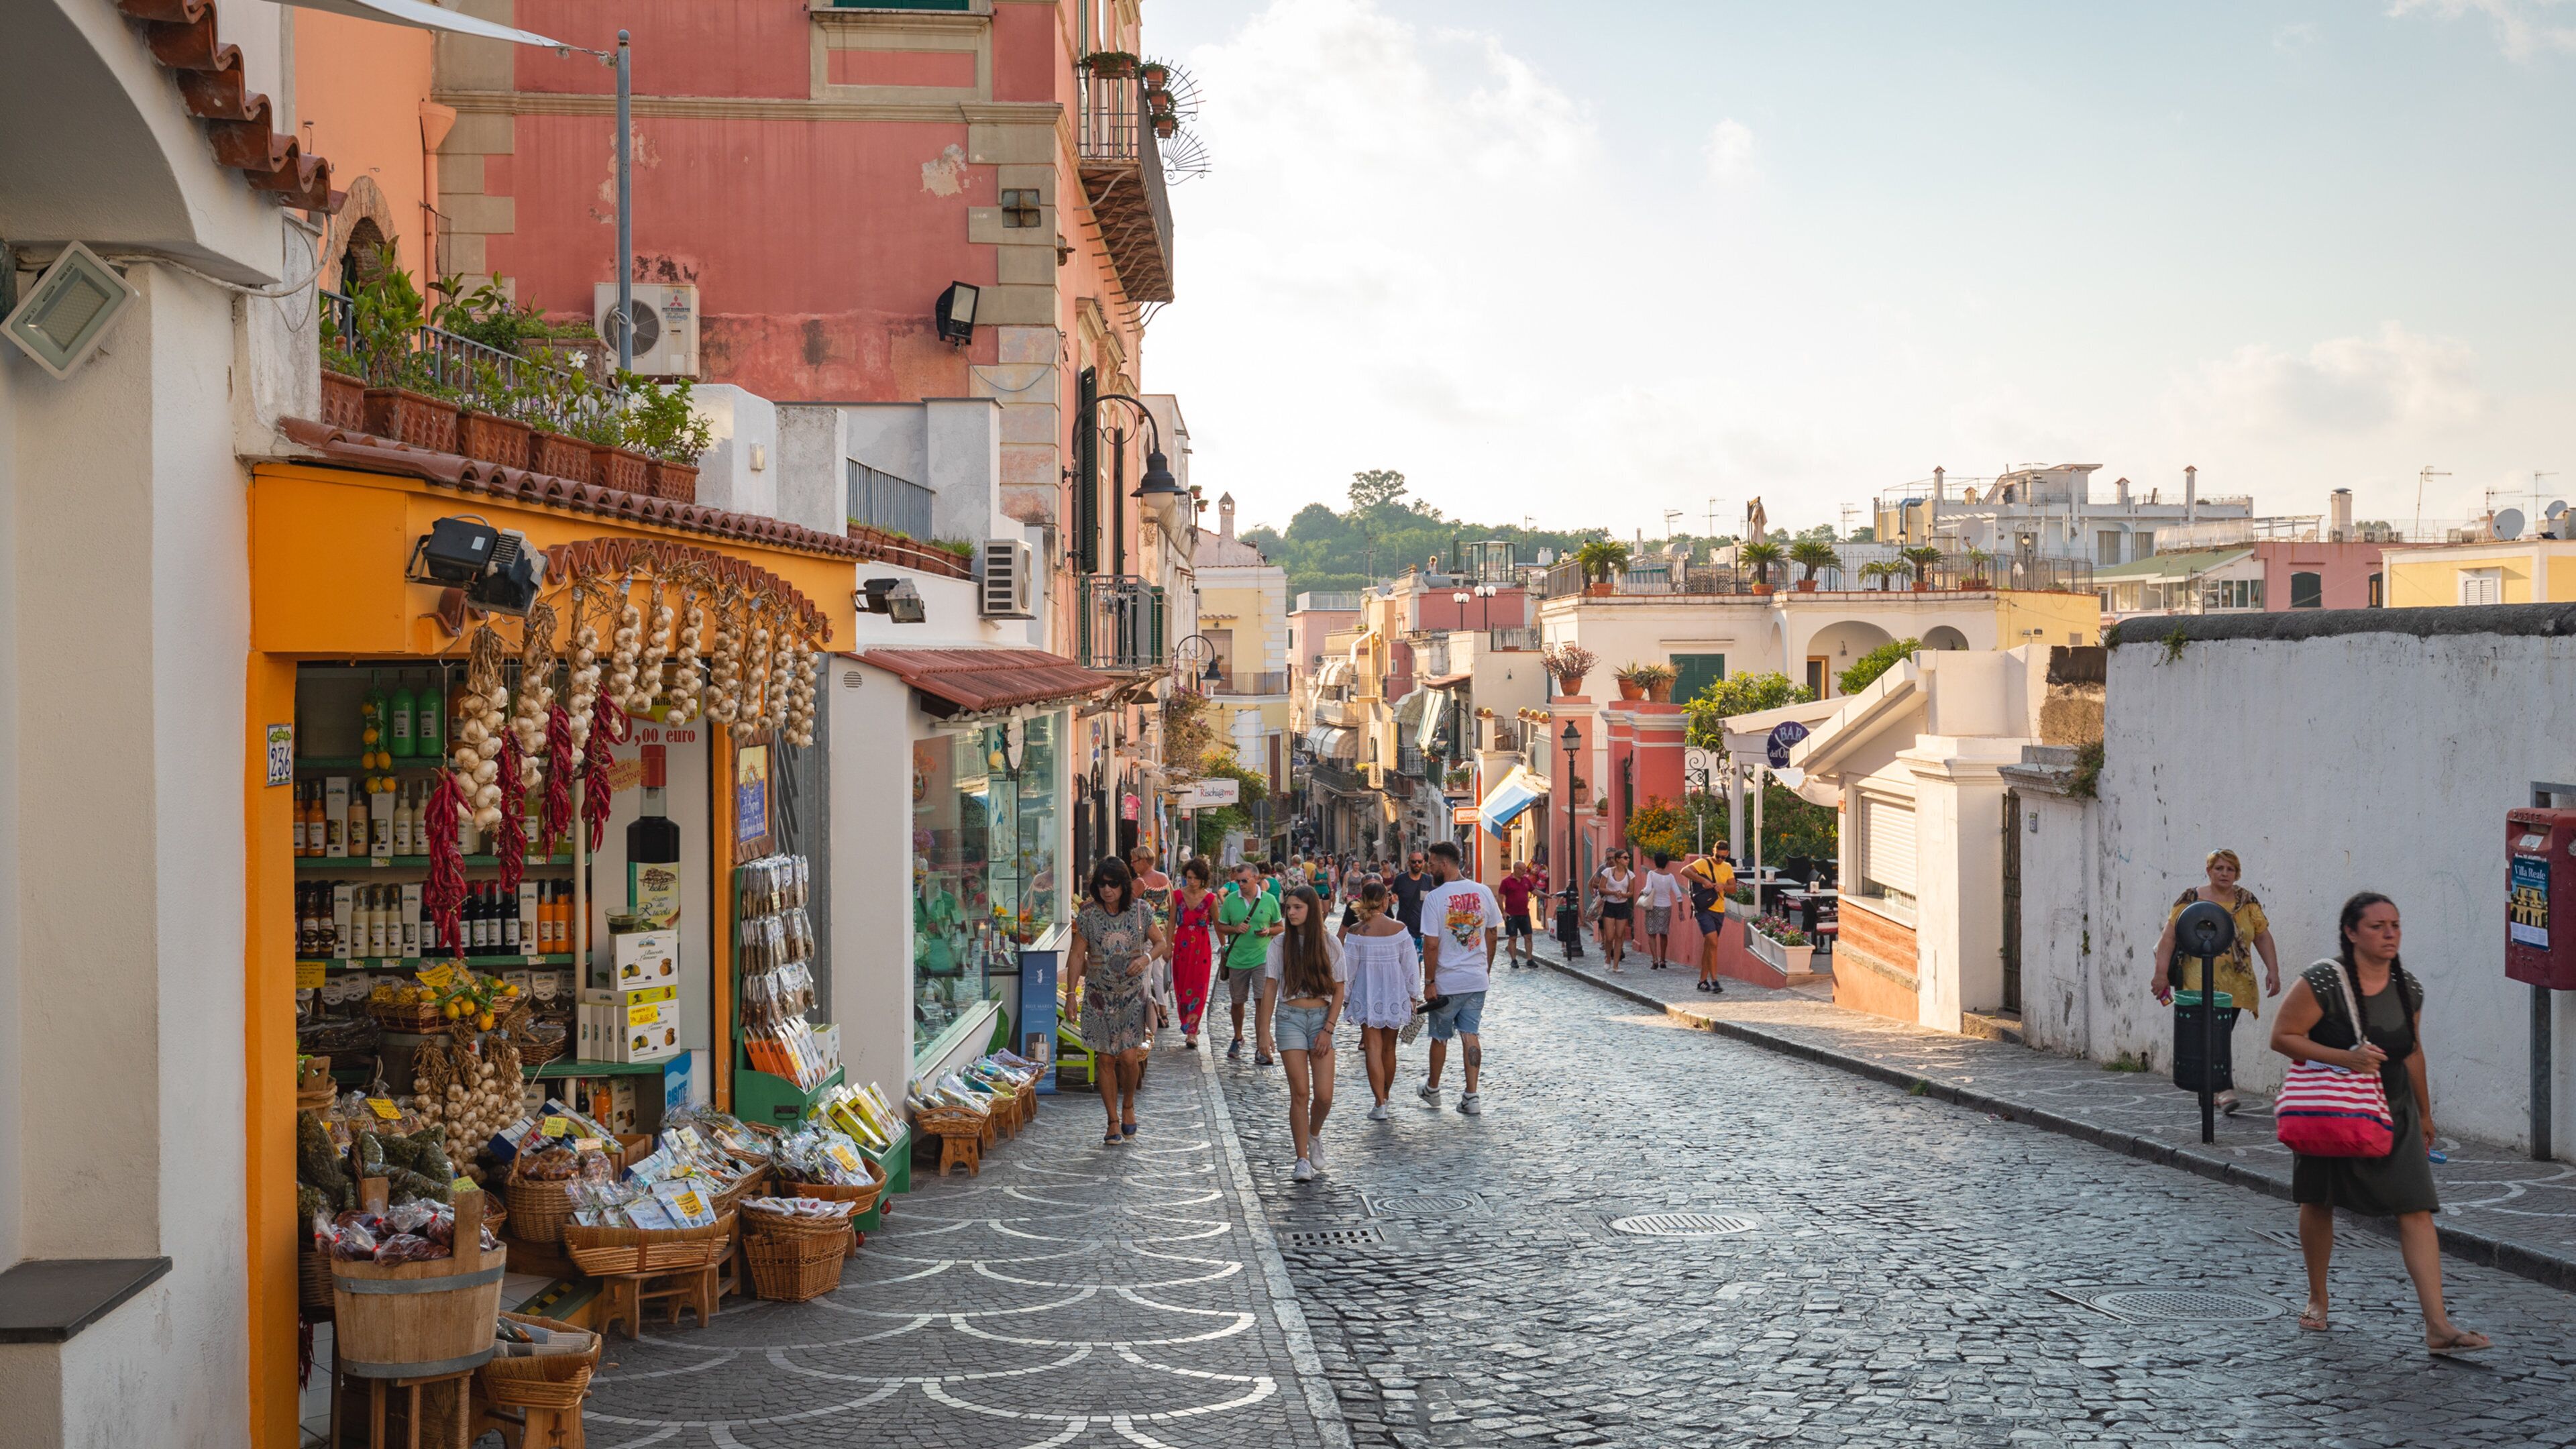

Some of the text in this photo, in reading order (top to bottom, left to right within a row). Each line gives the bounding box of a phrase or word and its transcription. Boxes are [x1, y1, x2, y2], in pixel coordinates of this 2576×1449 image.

[619, 717, 696, 747] 0,00 euro
[1779, 726, 1803, 741] BAR
[1770, 747, 1788, 759] dell'Or
[270, 746, 290, 777] 236
[609, 769, 641, 790] igestivo
[2513, 810, 2541, 822] POSTE
[2515, 865, 2527, 877] Villa
[2528, 867, 2546, 880] Reale
